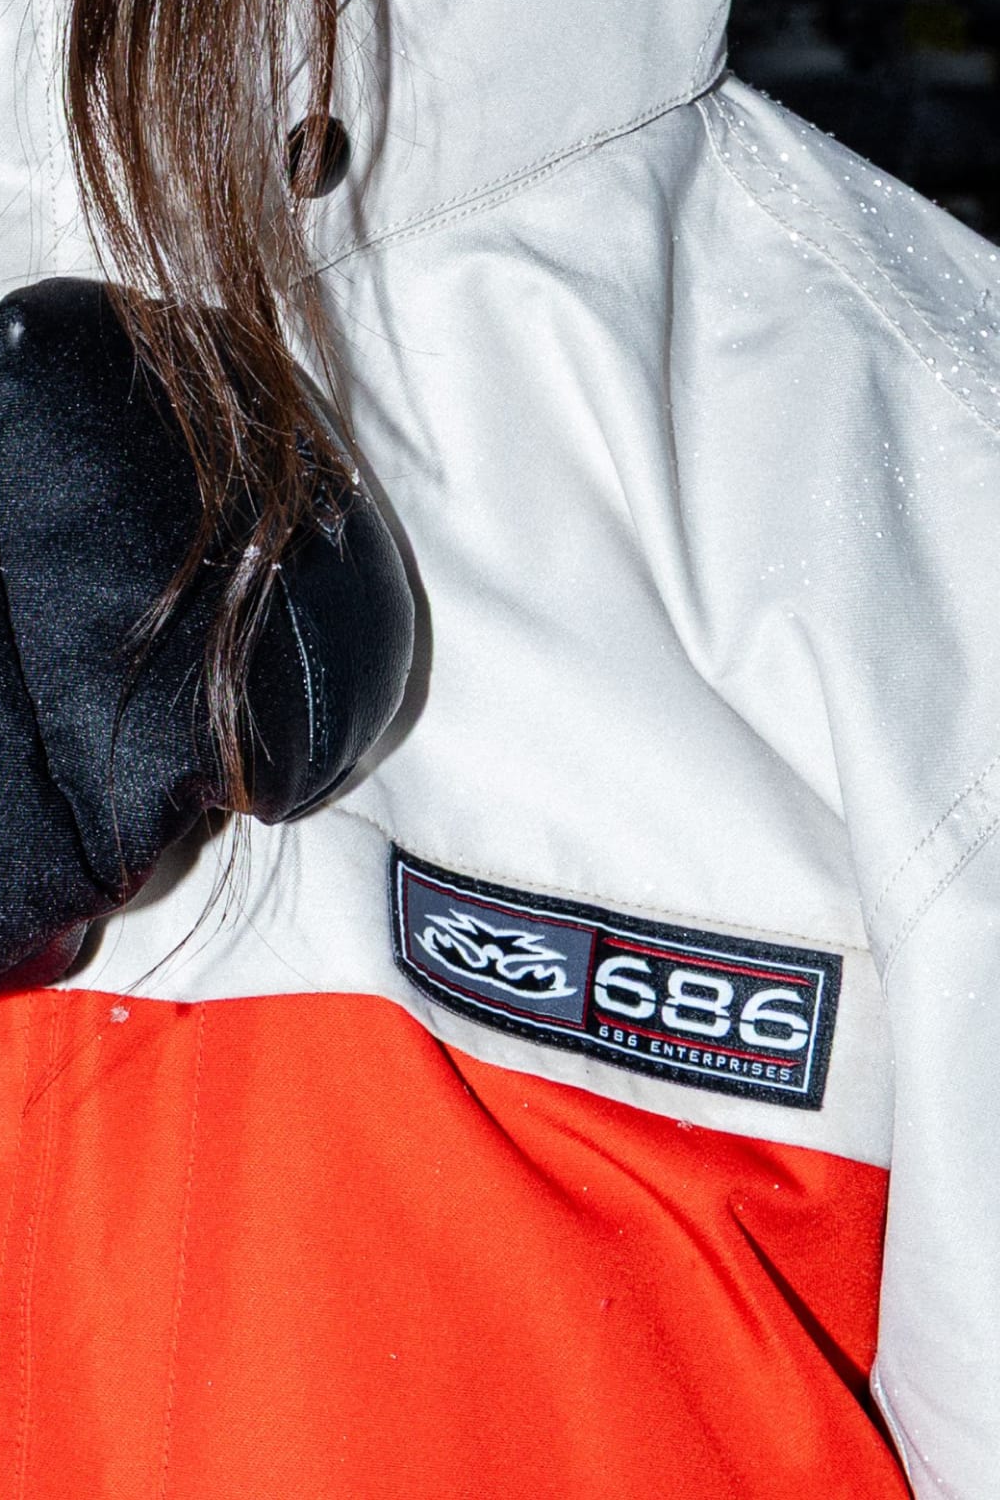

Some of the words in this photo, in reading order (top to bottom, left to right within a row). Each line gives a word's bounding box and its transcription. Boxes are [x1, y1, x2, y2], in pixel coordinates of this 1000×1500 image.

[594, 955, 809, 1051] 686
[599, 1025, 638, 1047] 686
[650, 1040, 793, 1082] ENTERPRISES
